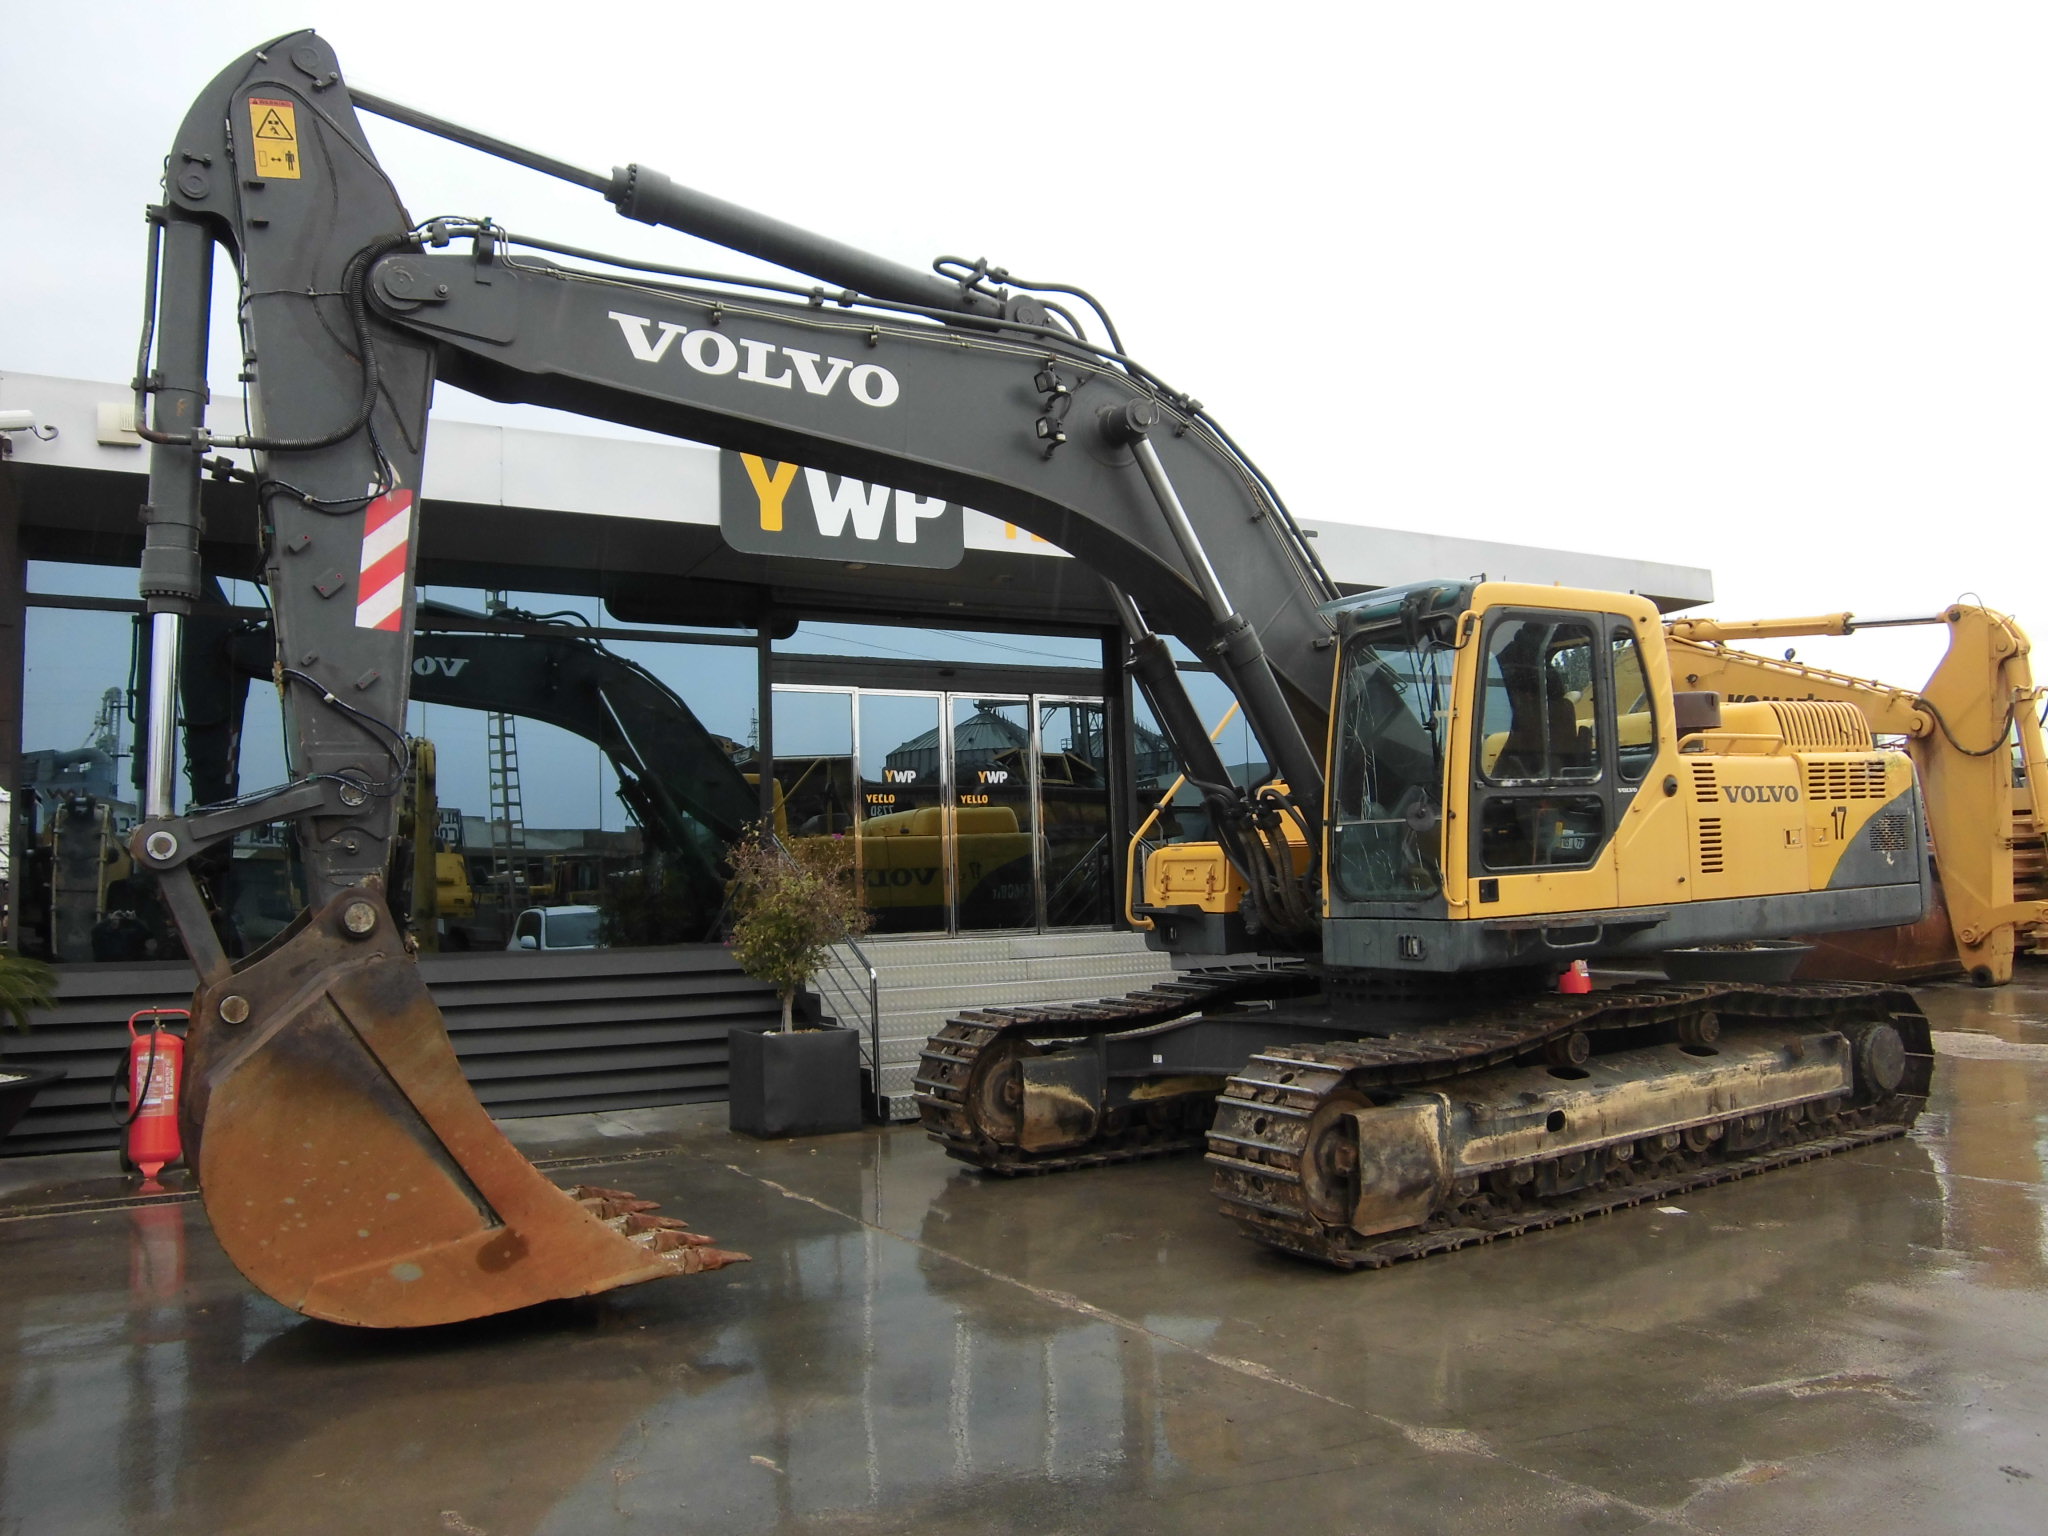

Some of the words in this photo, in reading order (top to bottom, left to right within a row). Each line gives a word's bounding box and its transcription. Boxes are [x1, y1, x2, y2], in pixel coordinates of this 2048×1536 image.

[608, 310, 900, 407] VOLVO
[739, 451, 947, 544] YWP
[885, 770, 916, 784] YWP
[978, 770, 1008, 784] YWP
[866, 794, 895, 804] YELLO
[960, 794, 989, 804] YELLO
[1721, 785, 1799, 803] VOLVO
[1831, 806, 1847, 840] 17
